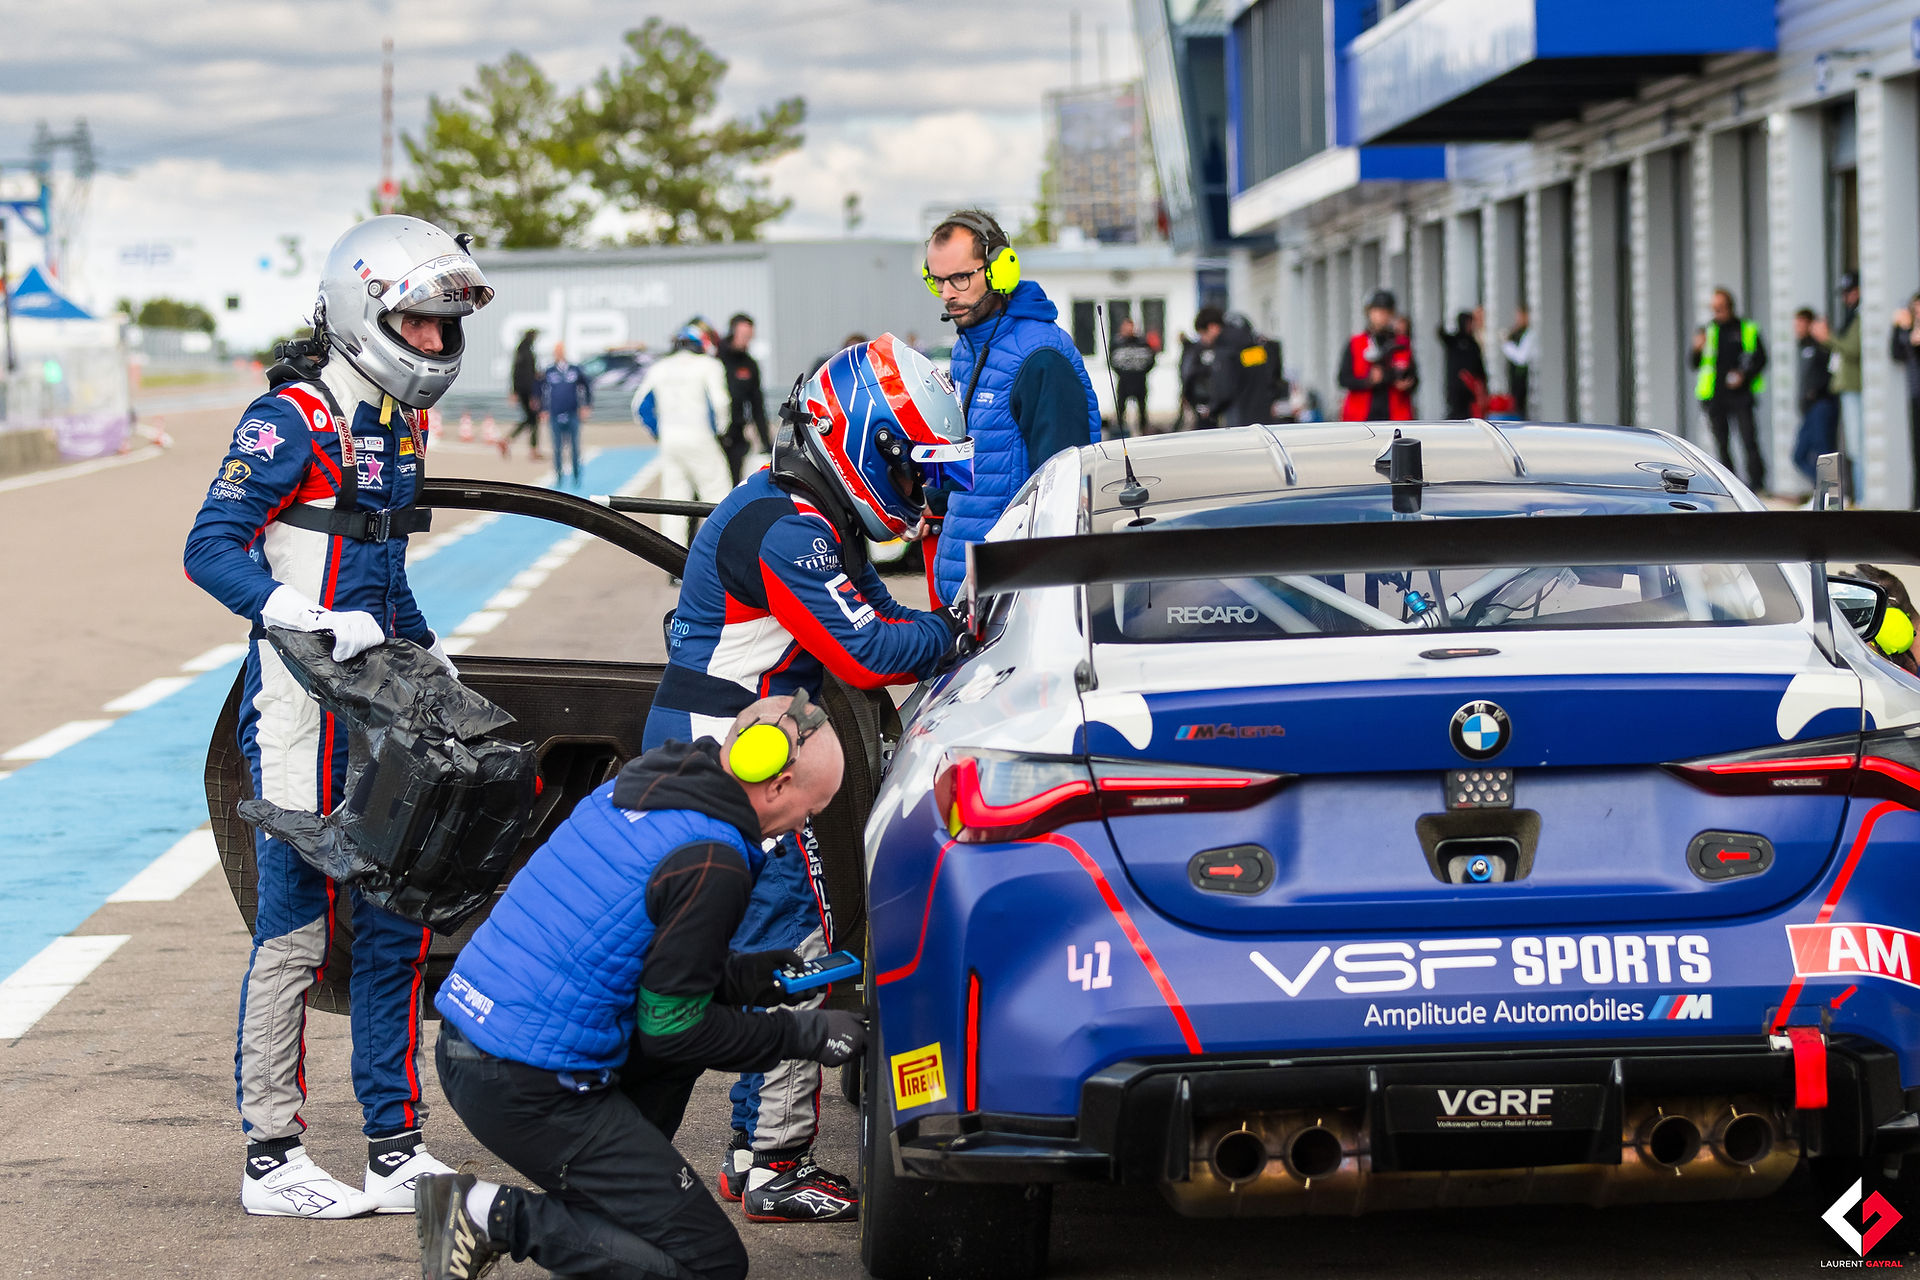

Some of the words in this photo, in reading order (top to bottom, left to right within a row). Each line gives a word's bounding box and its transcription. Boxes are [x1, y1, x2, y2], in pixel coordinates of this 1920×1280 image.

[339, 421, 353, 462] SIMPSON
[1167, 606, 1259, 624] RECARO
[1455, 703, 1507, 724] BMW
[1239, 726, 1285, 738] GT4
[1067, 940, 1113, 991] 41
[1249, 937, 1503, 997] VSF
[1511, 935, 1712, 986] SPORTS
[1827, 927, 1912, 980] AM
[1363, 1001, 1488, 1031] Amplitude
[1492, 999, 1644, 1025] Automobiles
[897, 1053, 942, 1097] PIRELLI
[1437, 1088, 1554, 1116] VGRF
[1436, 1119, 1479, 1128] Volkswagen
[1480, 1119, 1503, 1128] Group
[1504, 1119, 1526, 1127] Retail
